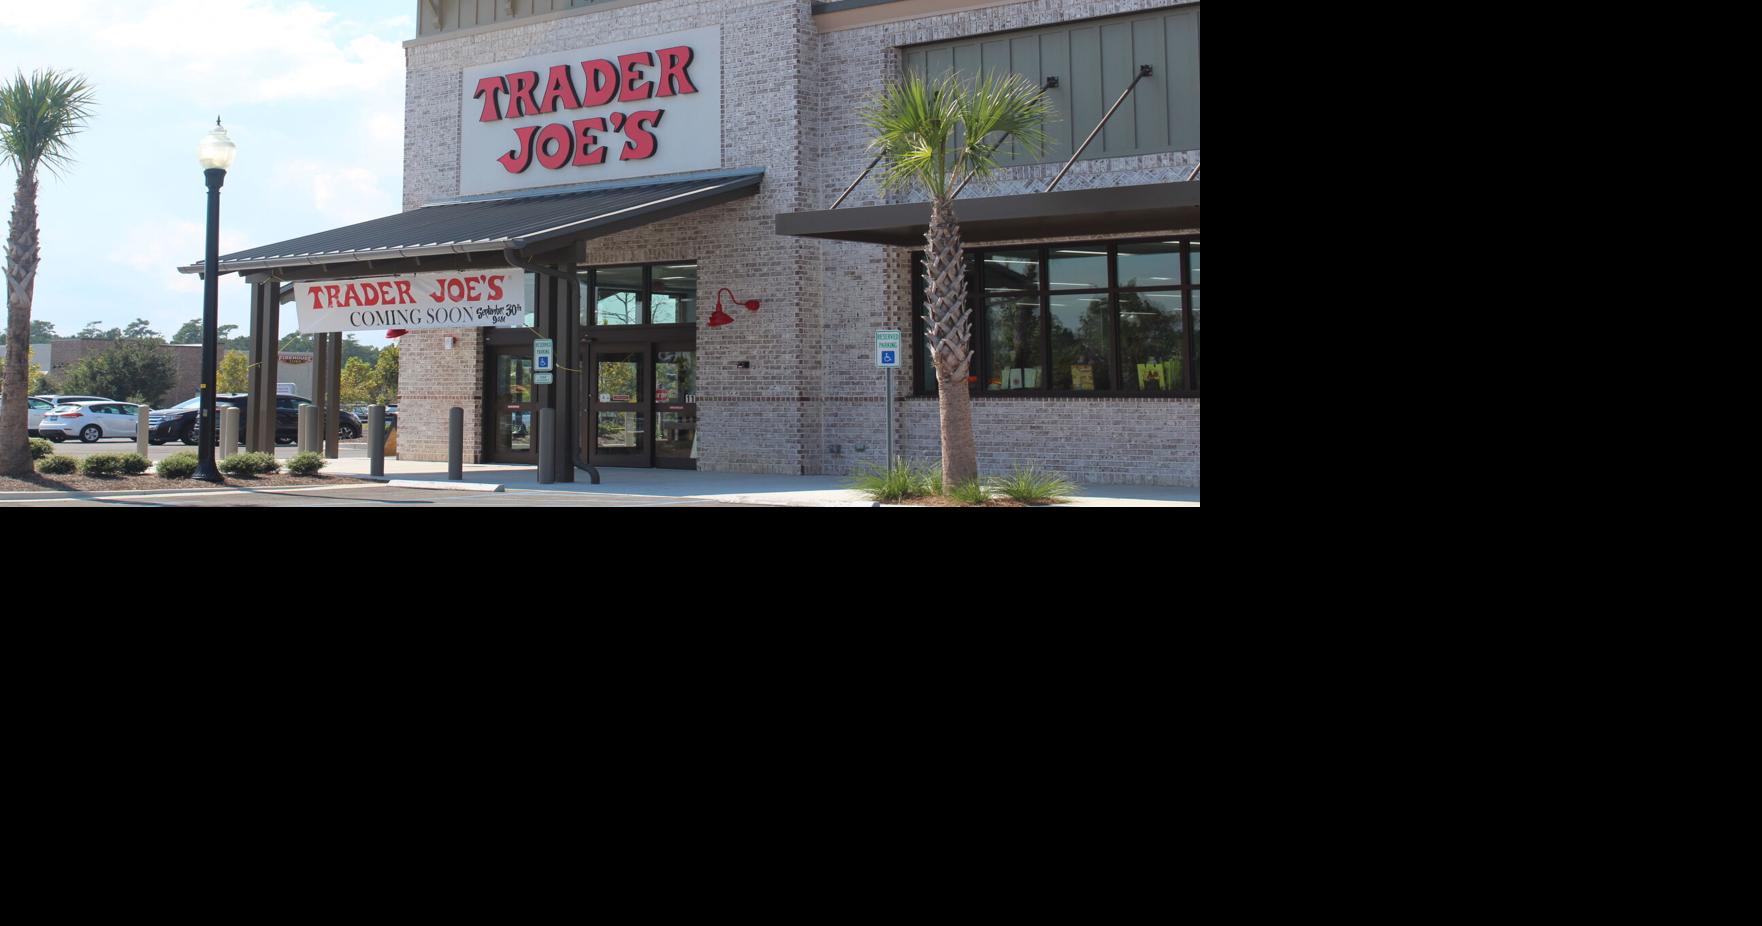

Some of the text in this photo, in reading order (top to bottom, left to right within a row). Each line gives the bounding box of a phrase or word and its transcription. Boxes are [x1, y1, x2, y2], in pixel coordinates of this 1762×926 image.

[473, 45, 699, 122] TRADER
[497, 109, 665, 174] JOE'S
[308, 274, 505, 309] TRADER JOE'S
[350, 307, 474, 327] COMING SOON
